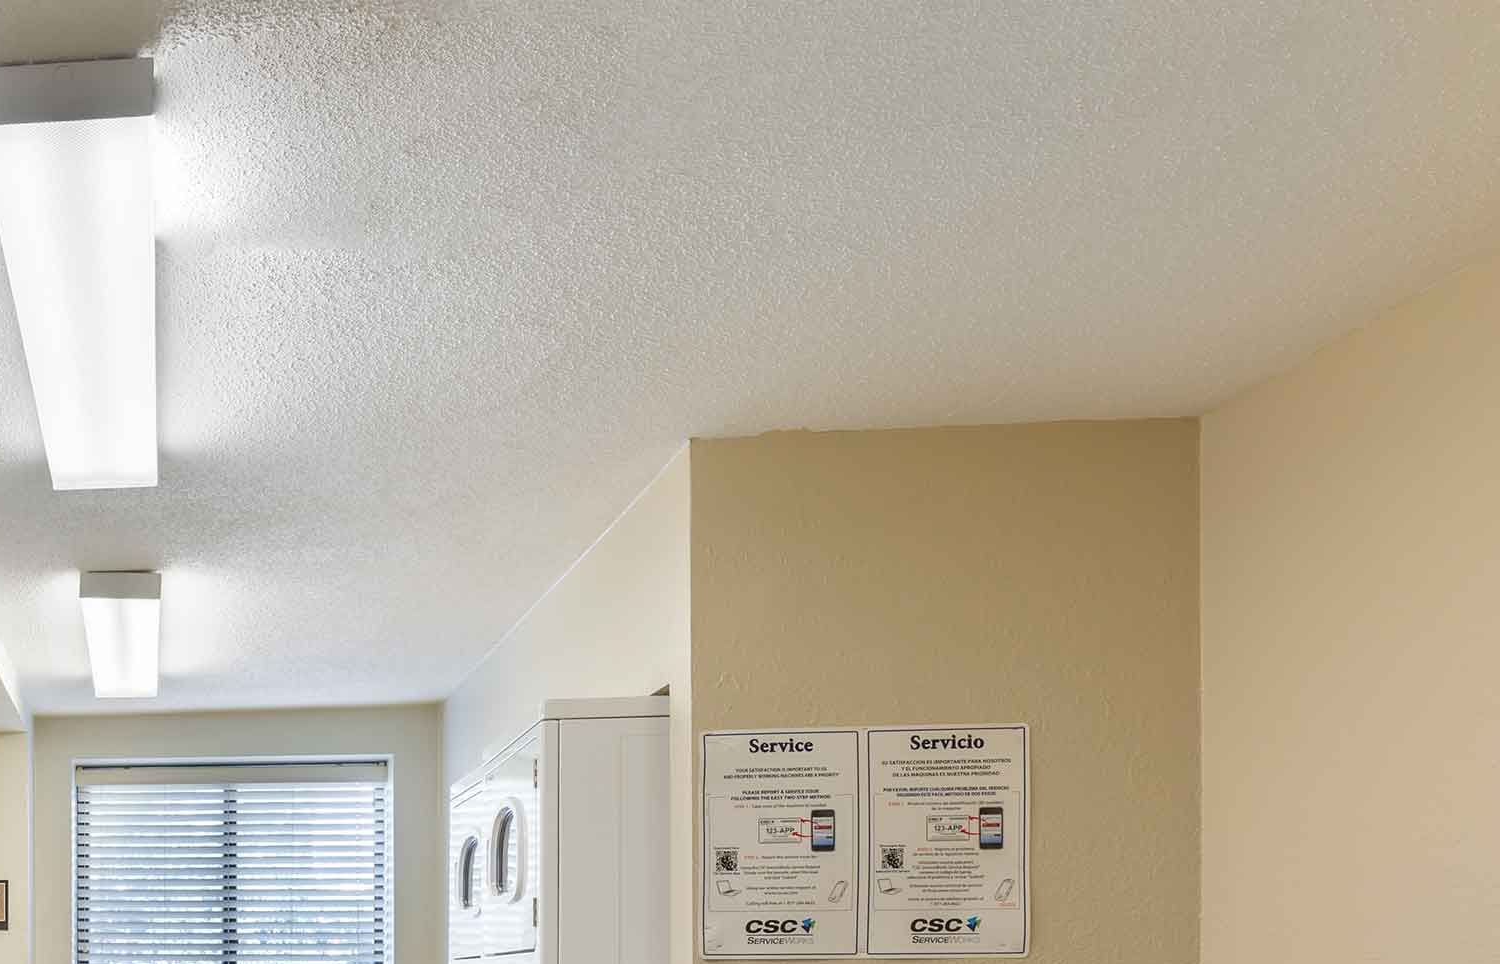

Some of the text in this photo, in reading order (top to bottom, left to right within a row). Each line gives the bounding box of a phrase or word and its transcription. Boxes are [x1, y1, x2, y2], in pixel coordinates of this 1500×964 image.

[749, 738, 814, 753] Service
[910, 734, 984, 750] Servicio
[745, 919, 798, 933] CSC
[910, 918, 963, 932] CSC
